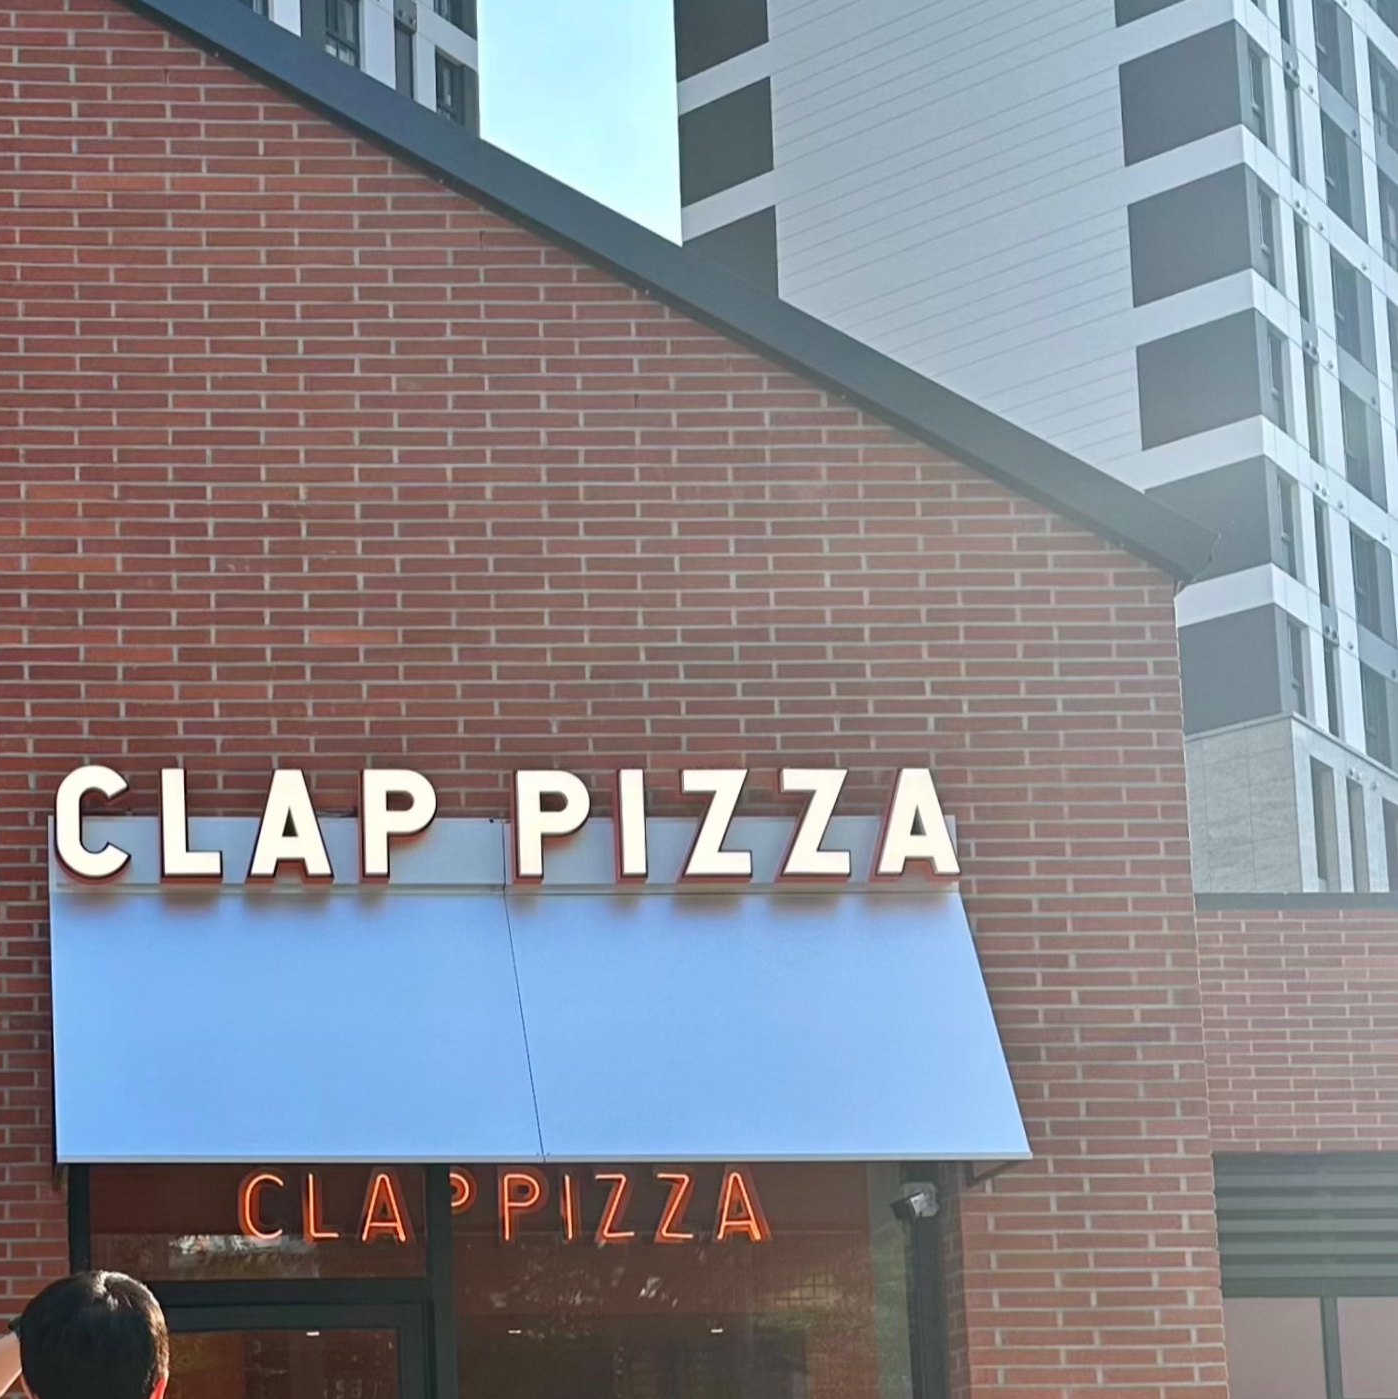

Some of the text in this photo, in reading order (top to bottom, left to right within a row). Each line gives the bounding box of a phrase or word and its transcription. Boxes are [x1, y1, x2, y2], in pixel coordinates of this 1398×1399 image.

[54, 764, 961, 881] CLAP PIZZA
[498, 1166, 771, 1243] PIZZA
